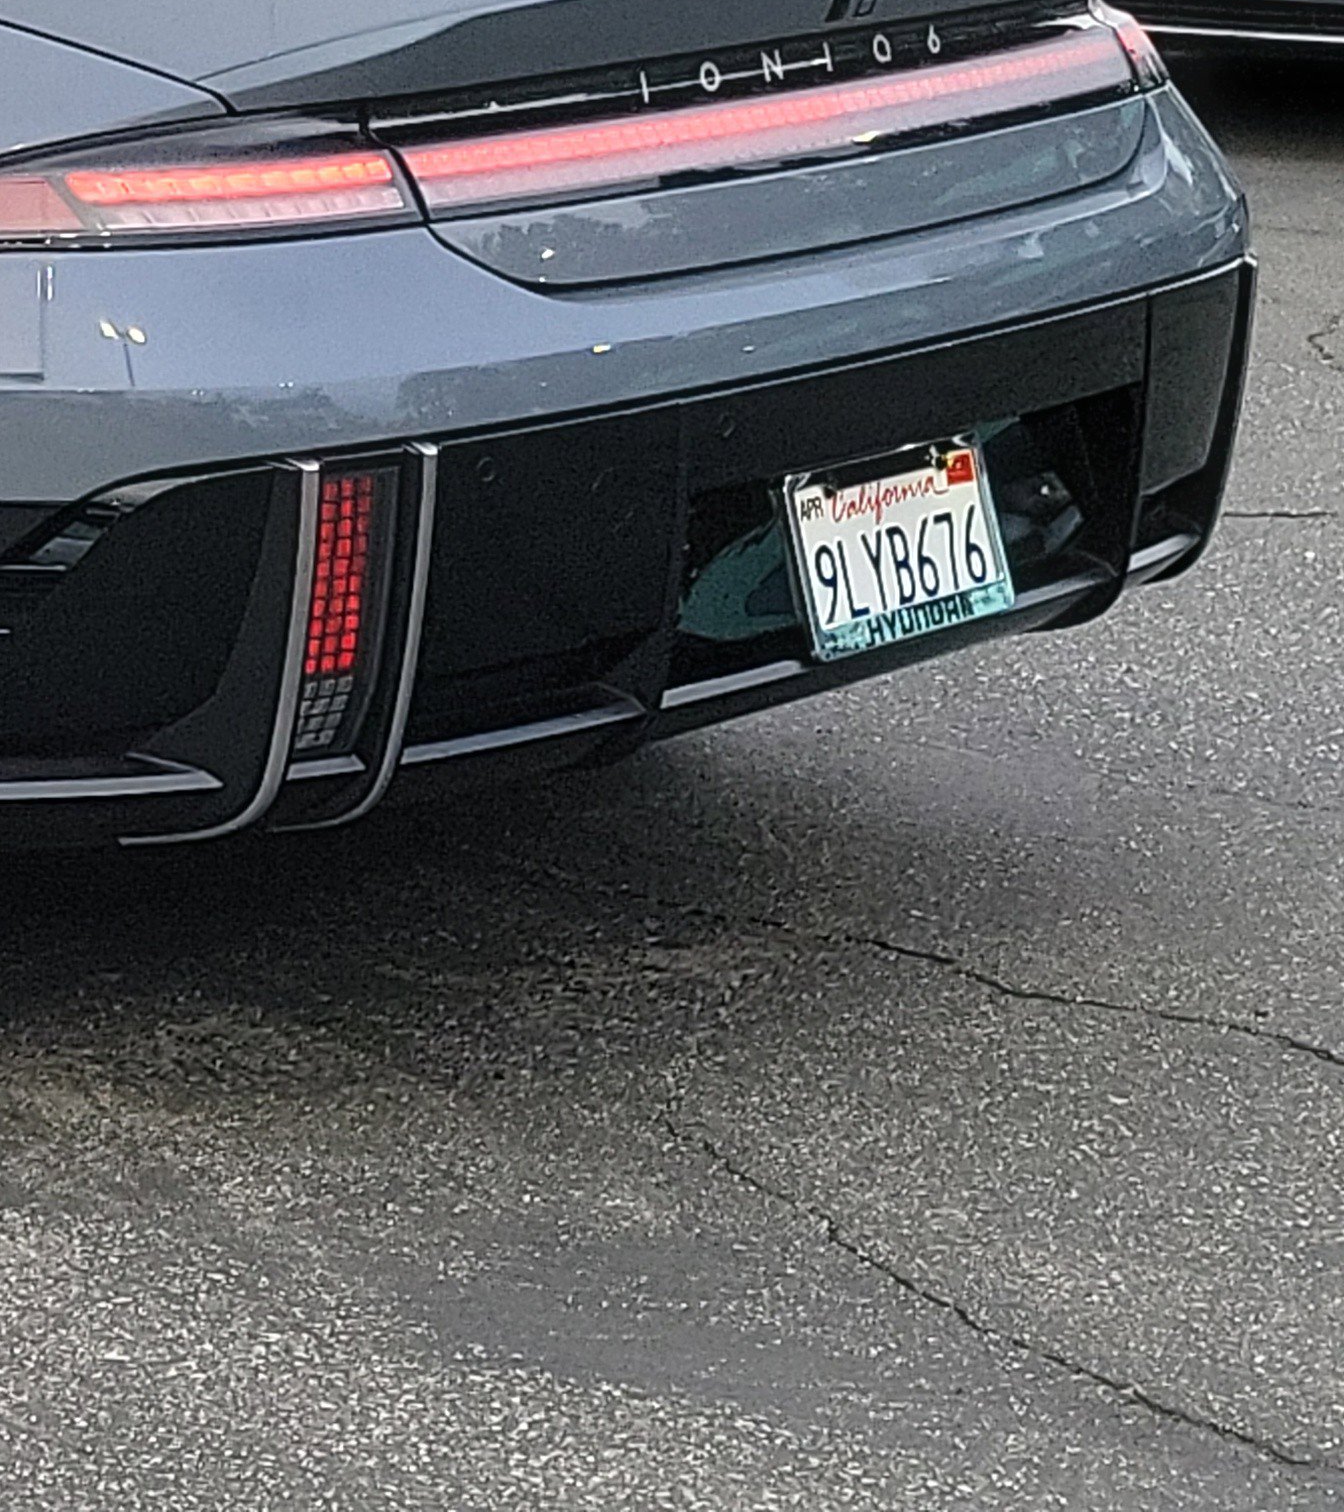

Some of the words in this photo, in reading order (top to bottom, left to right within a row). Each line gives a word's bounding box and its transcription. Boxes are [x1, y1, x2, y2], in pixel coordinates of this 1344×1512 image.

[926, 23, 941, 55] 6
[800, 496, 825, 523] APR
[830, 476, 949, 525] California
[814, 504, 988, 626] 9LYB676
[865, 593, 975, 647] HYUNDAI
